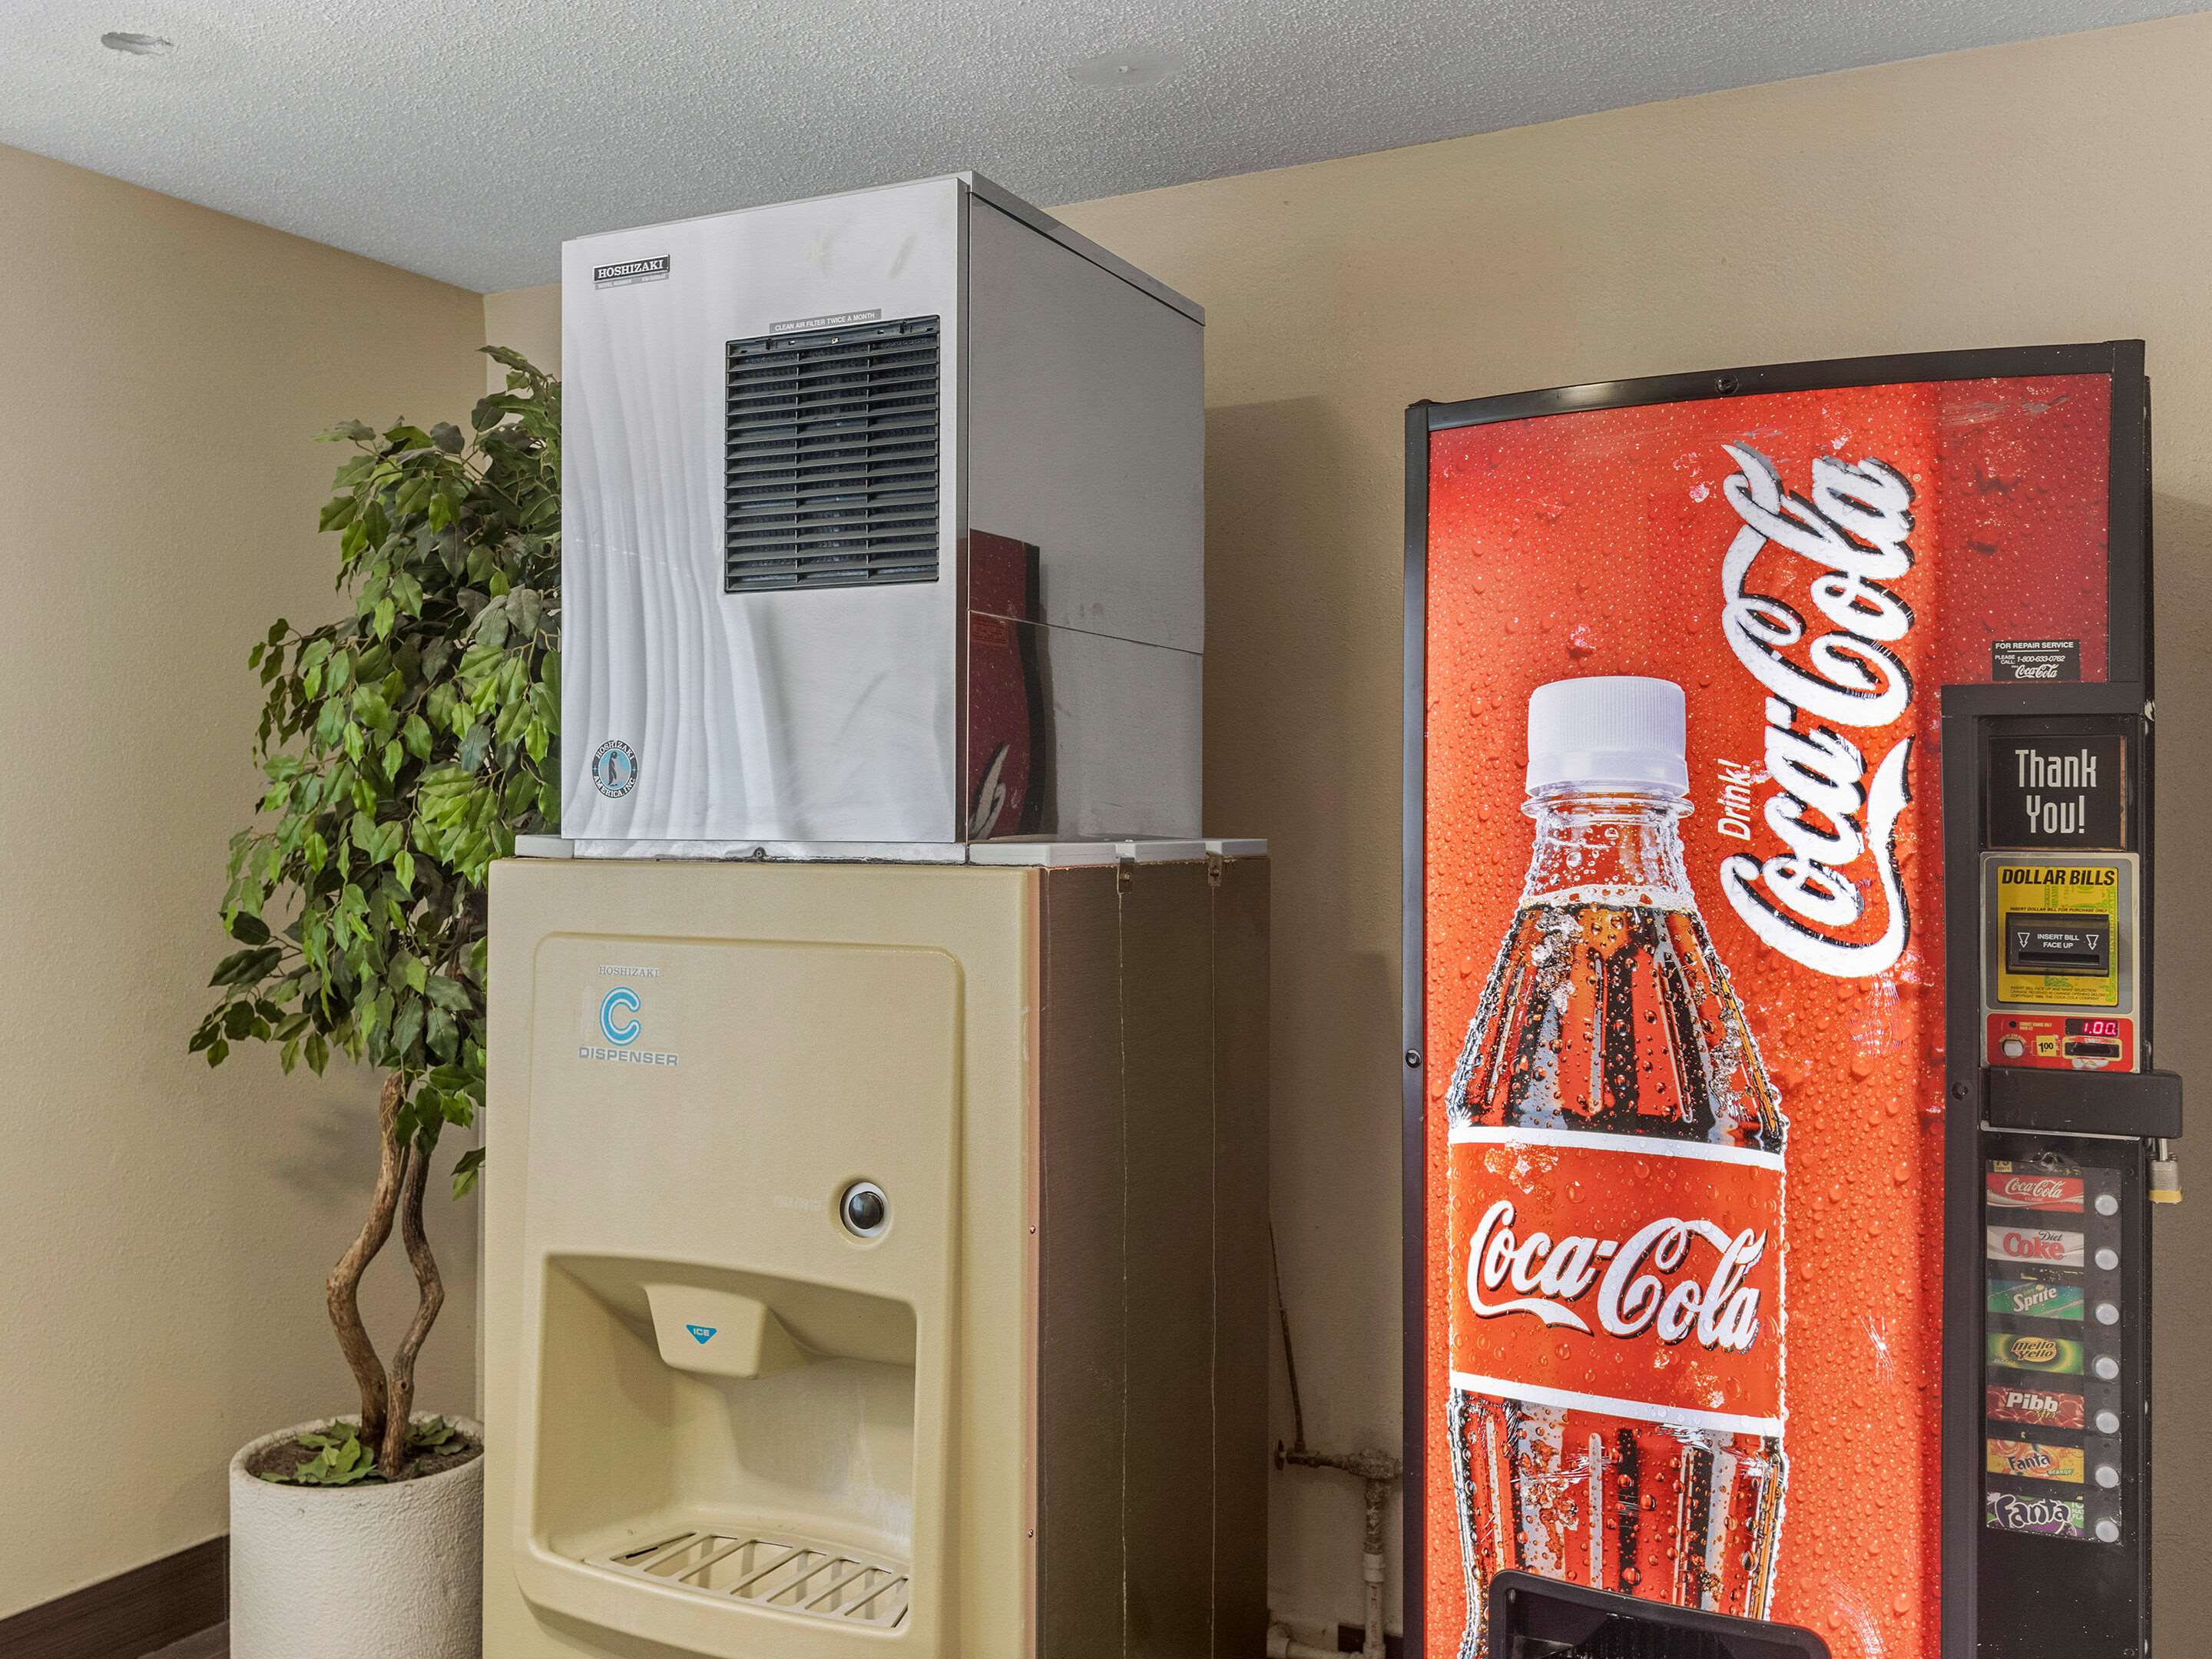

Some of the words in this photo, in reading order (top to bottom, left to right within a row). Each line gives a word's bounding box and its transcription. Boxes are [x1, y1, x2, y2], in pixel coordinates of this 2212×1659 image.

[598, 260, 664, 279] HOSHIZAKI
[774, 323, 794, 331] CLEAN
[806, 319, 826, 327] FILTER
[826, 316, 846, 325] TWICE
[853, 313, 875, 321] MONTH
[2015, 664, 2059, 679] Coca-Cola
[1720, 441, 1916, 978] Coca-Cola
[595, 740, 636, 760] HOSHIZAKI
[2015, 749, 2097, 787] Thank
[1717, 758, 1750, 841] Drink!
[2026, 795, 2085, 833] You!
[2002, 869, 2067, 885] DOLLAR
[2069, 869, 2115, 886] BILLS
[599, 965, 660, 977] HOSHIZAKI
[600, 986, 641, 1045] C
[578, 1046, 678, 1066] DISPENSER
[2005, 1177, 2065, 1198] Coca-Cola
[2002, 1230, 2066, 1260] Coke
[2038, 1230, 2064, 1241] Diet
[1467, 1200, 1768, 1354] Coca-Cola
[2013, 1287, 2058, 1313] Sprite
[693, 1327, 710, 1337] ICE
[2005, 1392, 2058, 1412] Pibb
[2007, 1452, 2051, 1471] Fanta
[1995, 1494, 2071, 1528] Fanta
